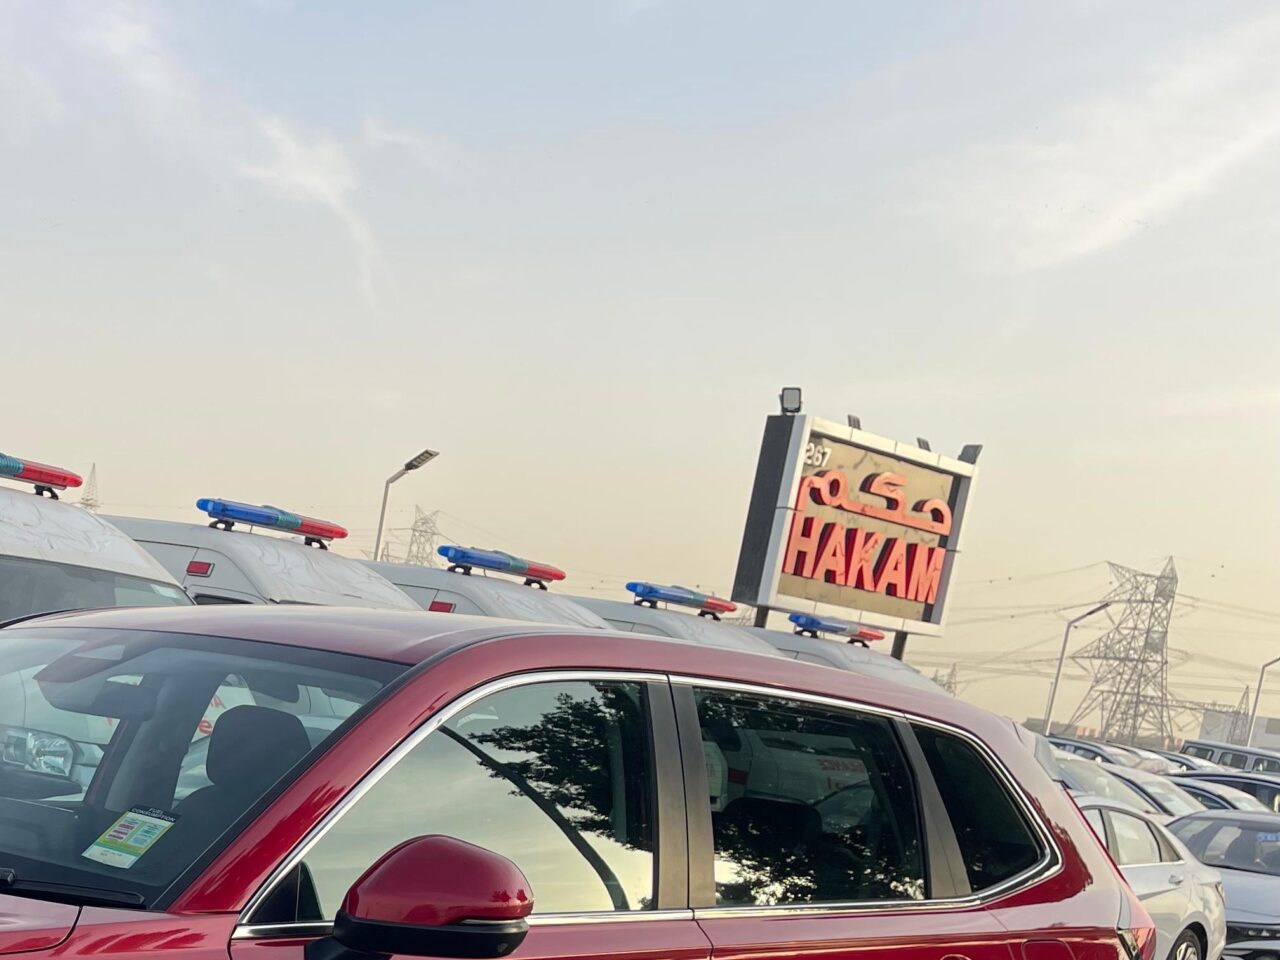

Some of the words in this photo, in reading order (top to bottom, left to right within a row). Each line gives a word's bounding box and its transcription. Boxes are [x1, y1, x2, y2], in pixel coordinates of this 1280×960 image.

[803, 442, 832, 467] 267
[794, 469, 952, 536] حكم
[782, 511, 947, 605] HAKAM
[131, 808, 175, 823] CONSUMPTION
